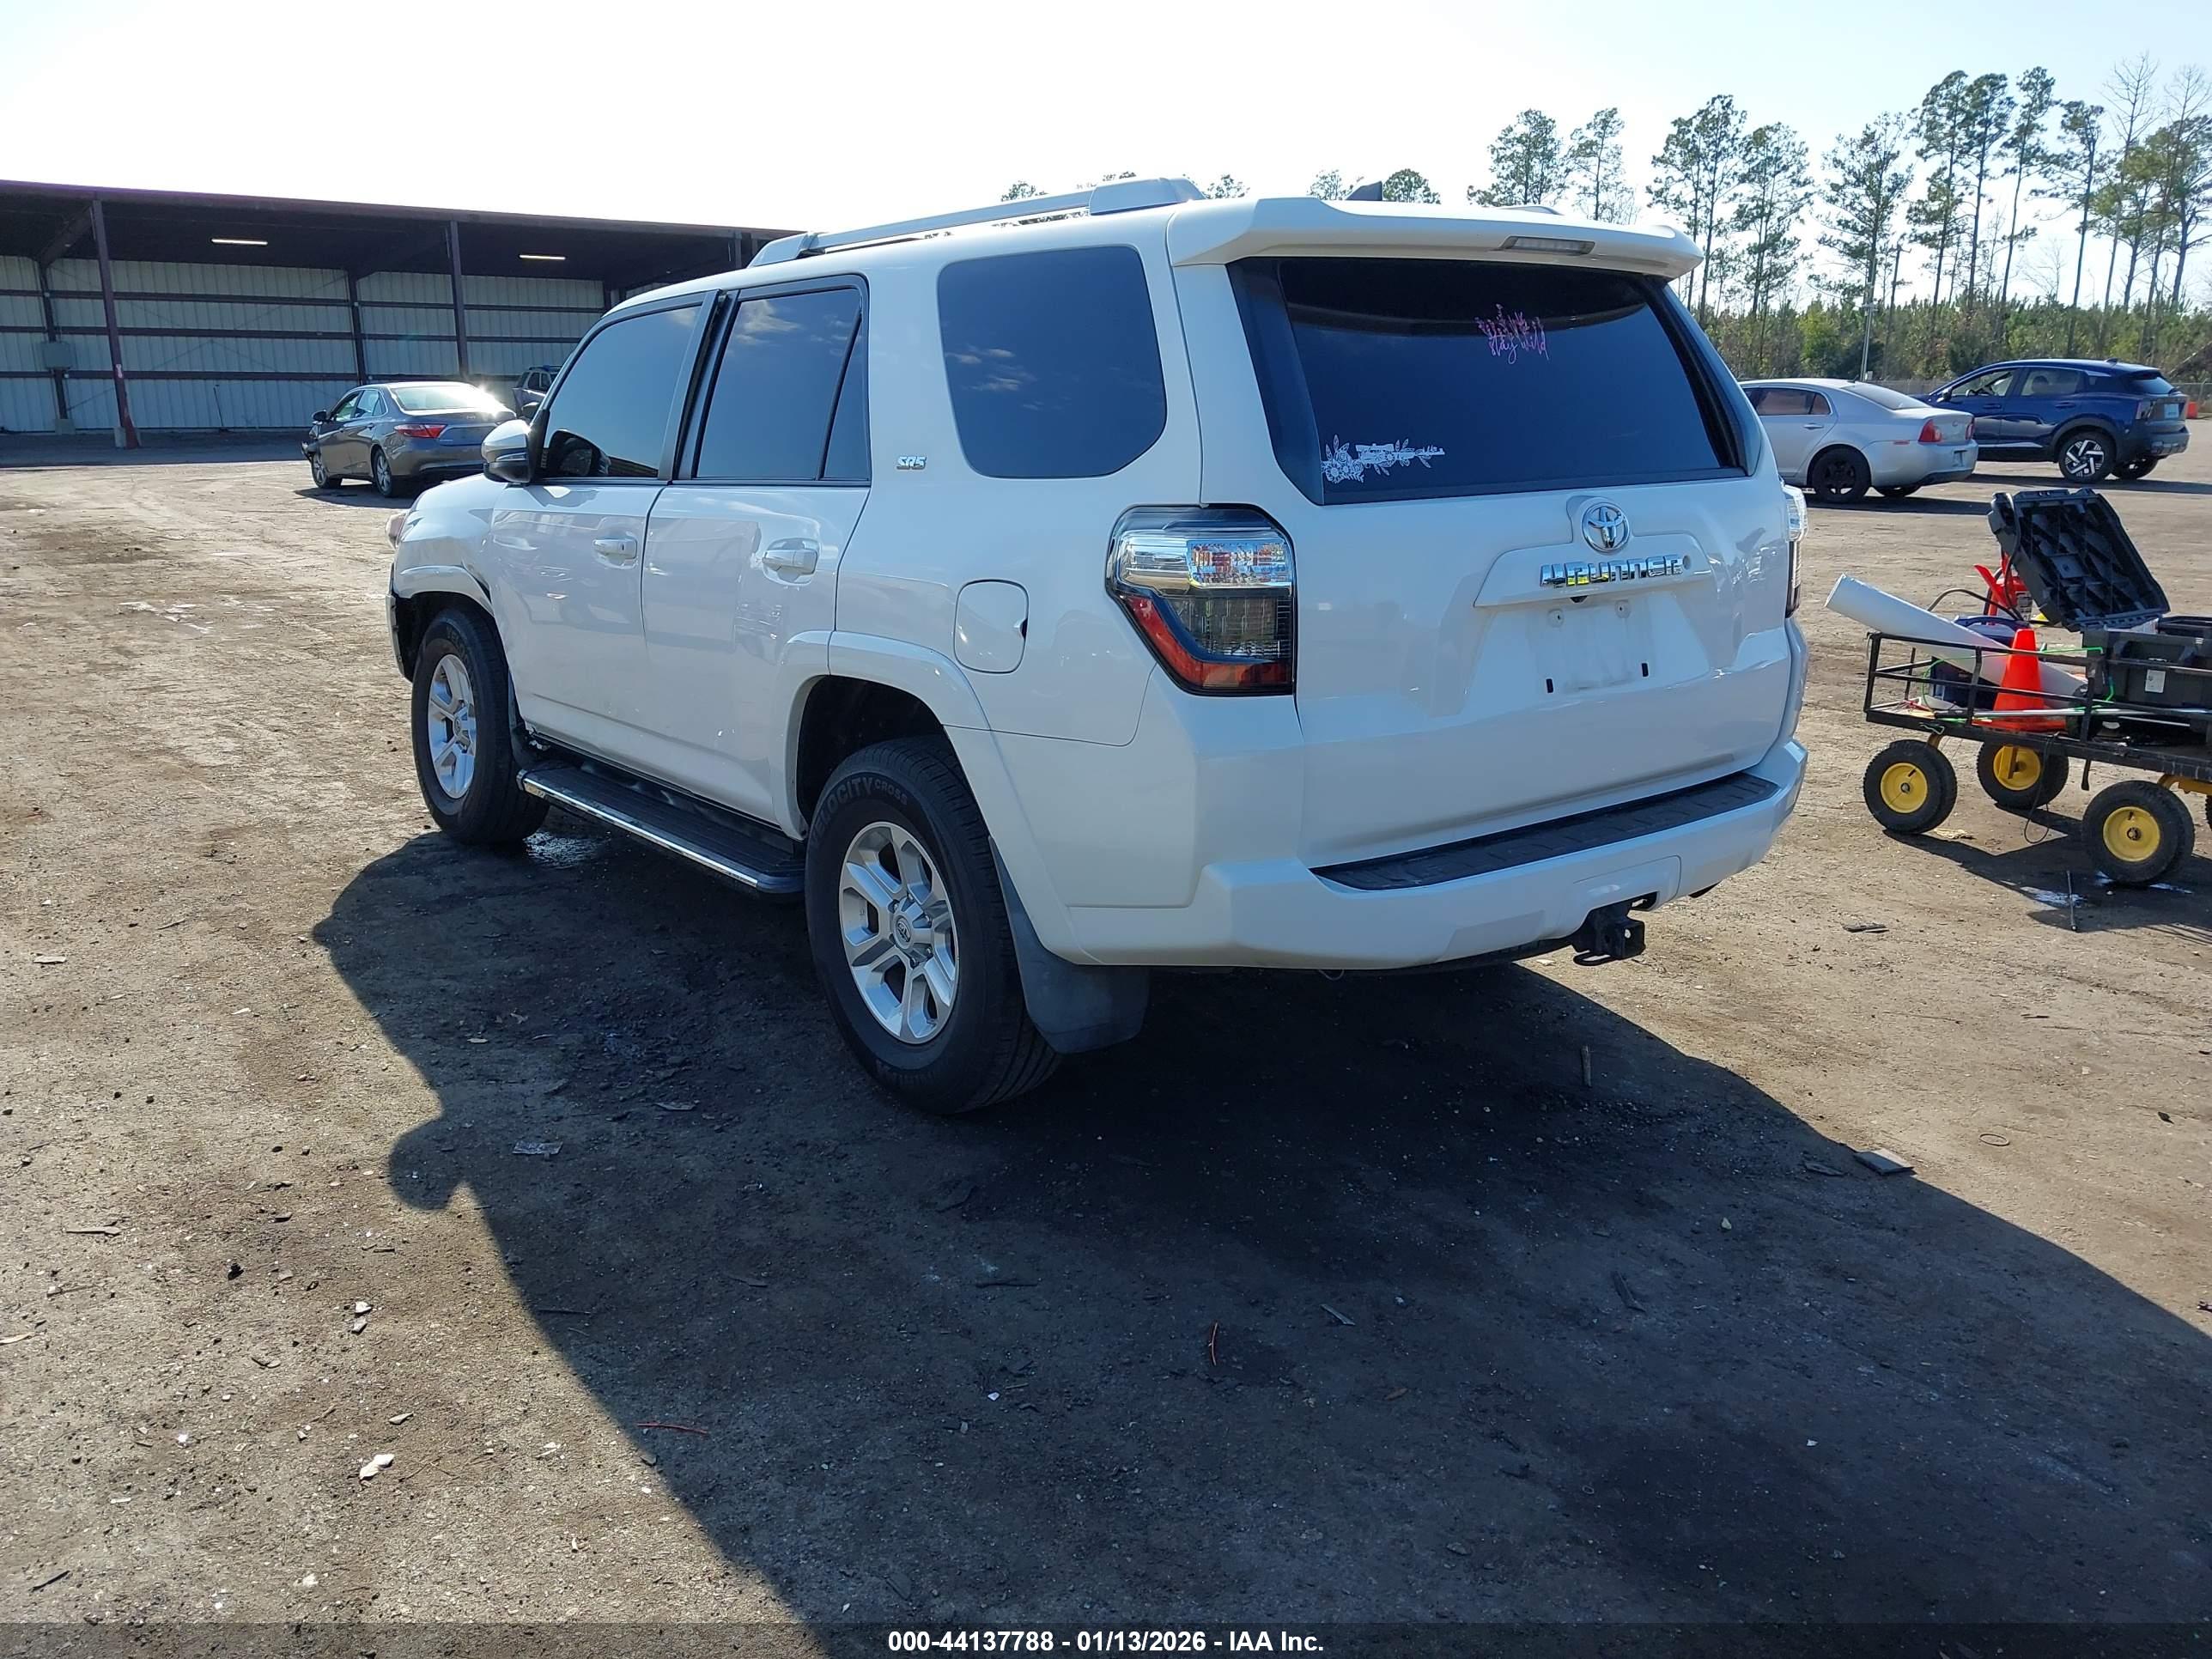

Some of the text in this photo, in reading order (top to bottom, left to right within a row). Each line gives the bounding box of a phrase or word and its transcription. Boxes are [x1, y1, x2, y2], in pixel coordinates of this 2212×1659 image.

[896, 455, 927, 471] SR5
[1539, 553, 1684, 587] 4RUNNER
[873, 778, 908, 805] CROSS
